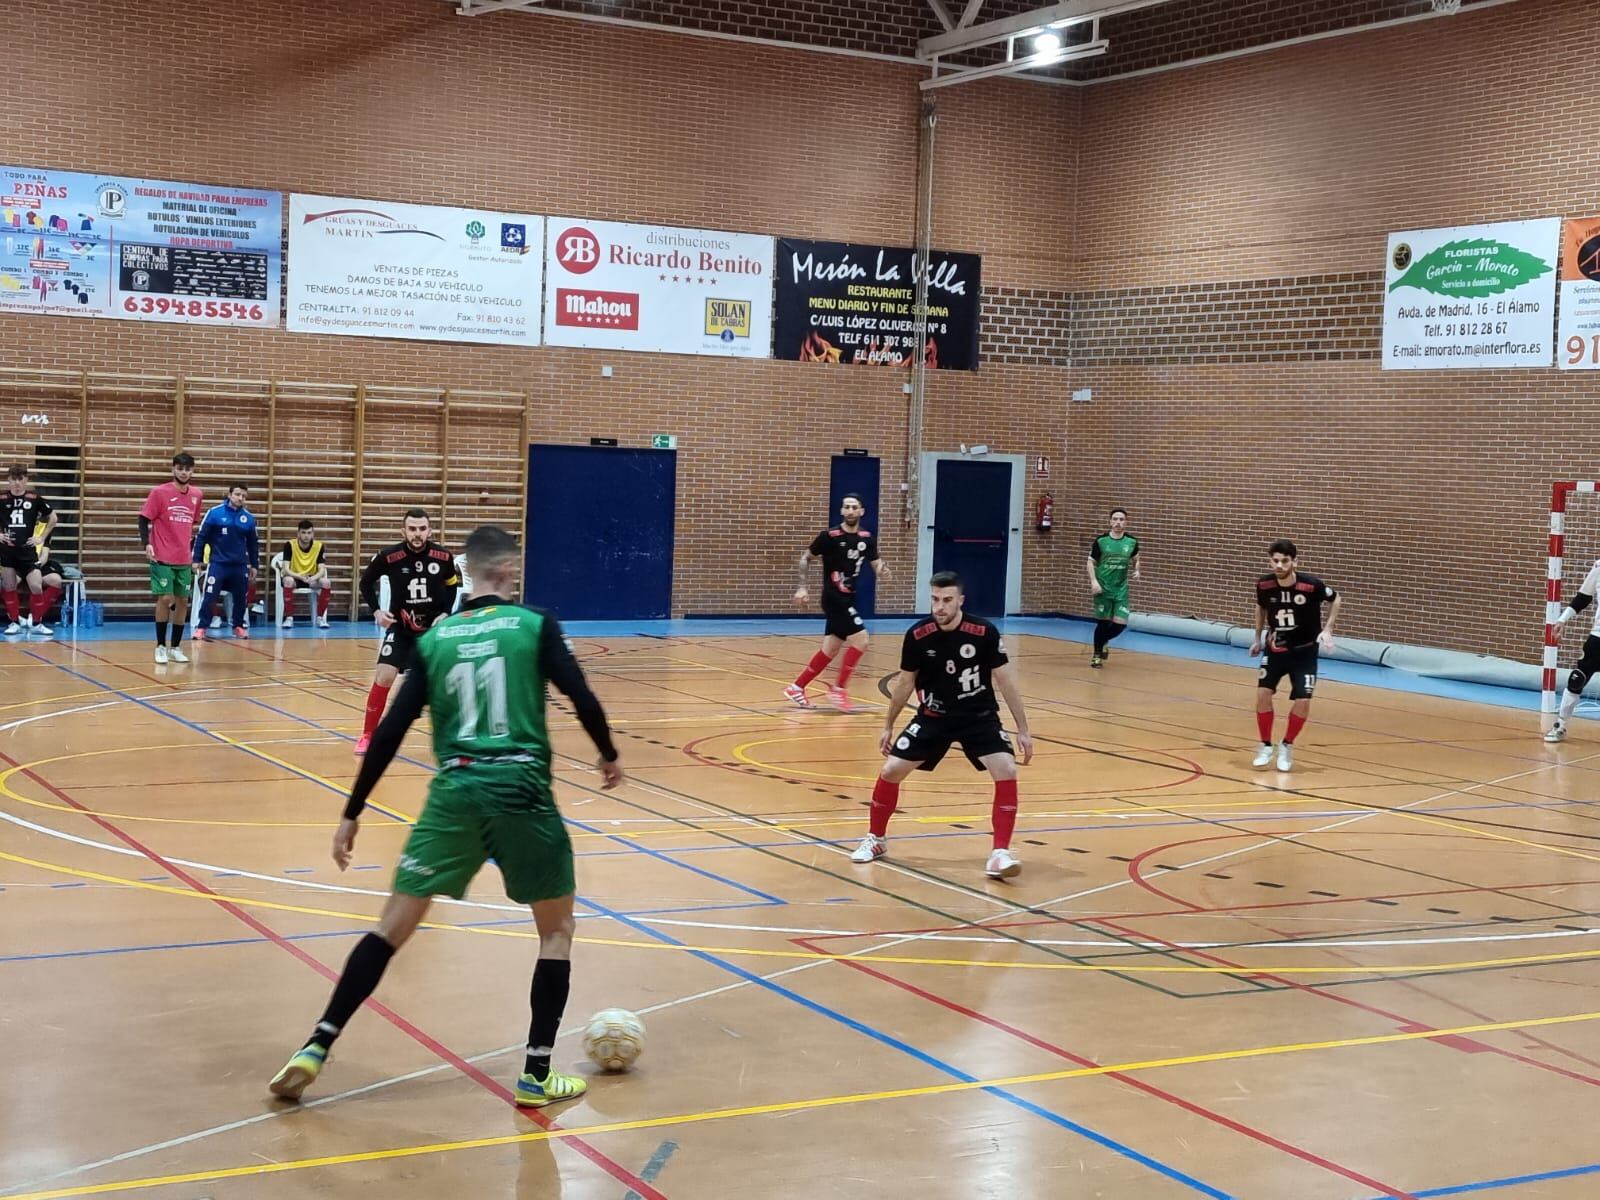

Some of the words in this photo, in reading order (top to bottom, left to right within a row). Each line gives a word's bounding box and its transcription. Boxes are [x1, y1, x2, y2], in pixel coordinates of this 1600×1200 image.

[4, 171, 25, 179] TODO
[14, 181, 68, 198] PEÑAS
[134, 187, 167, 198] REGALOS
[168, 190, 177, 200] DE
[211, 194, 231, 204] PARA
[162, 202, 198, 213] MATERIAL
[199, 204, 208, 213] DE
[209, 205, 237, 216] OFICINA
[186, 214, 214, 226] VINILOS
[216, 217, 257, 229] EXTERIORES
[366, 220, 418, 230] DESGUACES
[200, 226, 210, 237] DE
[170, 236, 190, 246] ROPA
[191, 238, 234, 249] DEPORTIVA
[646, 232, 730, 250] distribuciones
[122, 246, 154, 255] CENTRAL
[158, 248, 168, 256] DE
[1445, 246, 1499, 258] FLORISTAS
[122, 254, 150, 262] COMPRAS
[152, 256, 168, 264] PARA
[122, 260, 168, 270] COLECTIVOS
[608, 244, 692, 270] Ricardo
[699, 252, 762, 276] Benito
[374, 264, 410, 275] VENTAS
[412, 267, 424, 276] DE
[426, 268, 459, 278] PIEZAS
[792, 251, 866, 284] Mesón
[875, 250, 900, 282] La
[1475, 258, 1520, 276] Morato
[348, 274, 381, 285] DAMOS
[383, 277, 395, 286] DE
[397, 278, 421, 288] BAJA
[424, 280, 436, 288] SU
[439, 281, 484, 292] VEHICULO
[1442, 279, 1466, 288] Servicio
[1472, 277, 1500, 287] domicilio
[305, 284, 350, 295] TENEMOS
[352, 288, 364, 296] LA
[366, 289, 398, 298] MEJOR
[401, 290, 448, 302] TASACIÓN
[450, 294, 461, 303] DE
[464, 296, 476, 304] SU
[479, 296, 522, 307] VEHICULO
[847, 285, 913, 300] RESTAURANTE
[124, 296, 263, 320] 639485546
[362, 307, 371, 315] 91
[374, 307, 388, 316] 812
[390, 308, 401, 317] 09
[404, 309, 415, 318] 44
[566, 294, 632, 317] Mahou
[809, 298, 837, 310] MENU
[838, 299, 870, 312] DIARIO
[871, 301, 878, 312] Y
[880, 302, 895, 313] FIN
[897, 304, 908, 315] DE
[1398, 306, 1423, 319] Avda.
[1426, 306, 1436, 317] de
[1476, 303, 1488, 315] 16
[1496, 301, 1506, 314] El
[1508, 298, 1540, 313] Álamo
[476, 314, 485, 323] 91
[487, 314, 500, 324] 810
[503, 316, 514, 324] 43
[515, 316, 526, 325] 62
[710, 316, 718, 326] DE
[810, 314, 844, 328] C/LUIS
[846, 315, 876, 330] LÓPEZ
[928, 322, 939, 333] Nº
[940, 323, 947, 334] 8
[1424, 324, 1443, 337] Telf.
[1446, 324, 1456, 336] 91
[1459, 323, 1478, 336] 812
[1481, 322, 1493, 335] 28
[1495, 322, 1508, 334] 67
[838, 332, 861, 345] TELF
[863, 334, 880, 346] 611
[883, 335, 899, 346] 307
[855, 349, 867, 361] EL
[1393, 344, 1422, 357] E-mail:
[1424, 341, 1541, 357] gmorato.m@interflora.es
[14, 499, 23, 507] 17
[414, 561, 424, 572] 9
[407, 578, 427, 598] fi
[1280, 591, 1291, 603] 11
[1275, 608, 1295, 627] fi
[946, 660, 956, 674] 8
[958, 664, 980, 692] fi
[445, 656, 510, 741] 11
